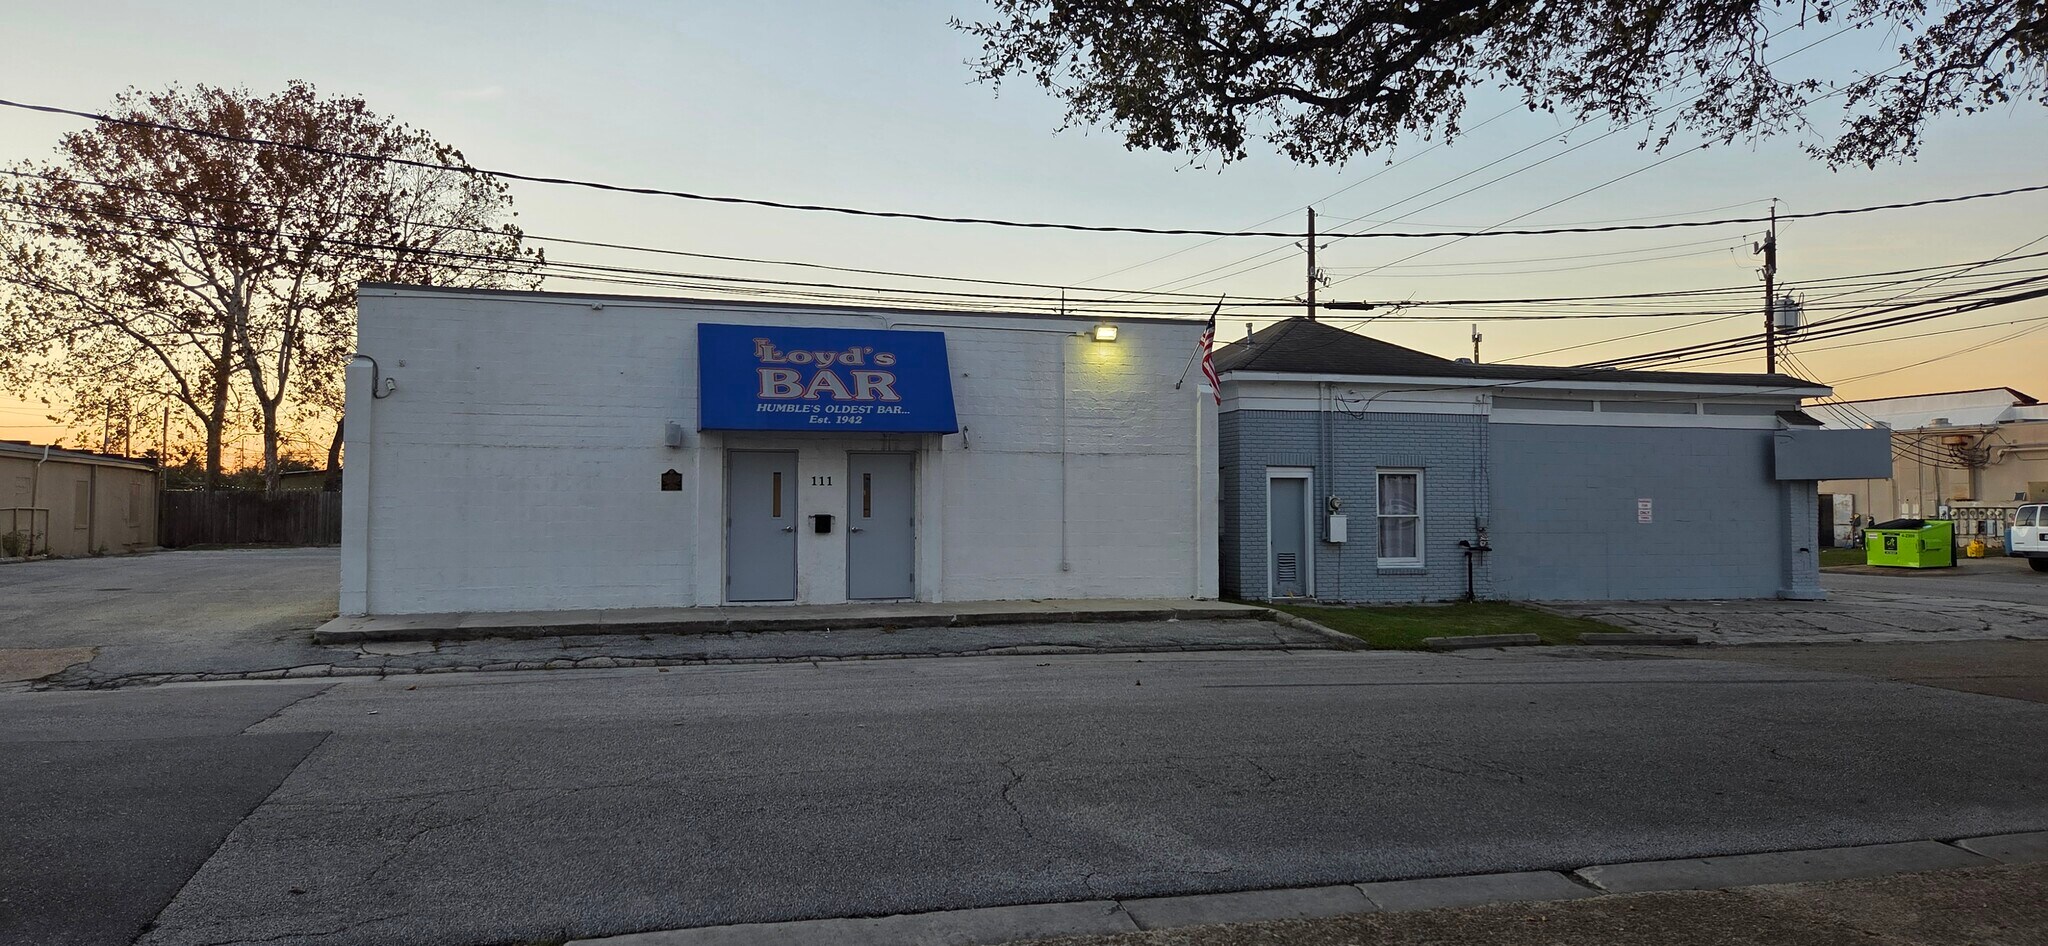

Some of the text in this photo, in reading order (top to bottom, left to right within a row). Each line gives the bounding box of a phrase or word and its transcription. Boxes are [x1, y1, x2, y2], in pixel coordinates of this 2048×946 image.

[757, 367, 902, 402] BAR
[756, 403, 911, 415] HUMBLE'S OLDEST BAR...
[808, 415, 863, 425] Est. 1942
[811, 475, 833, 487] 111
